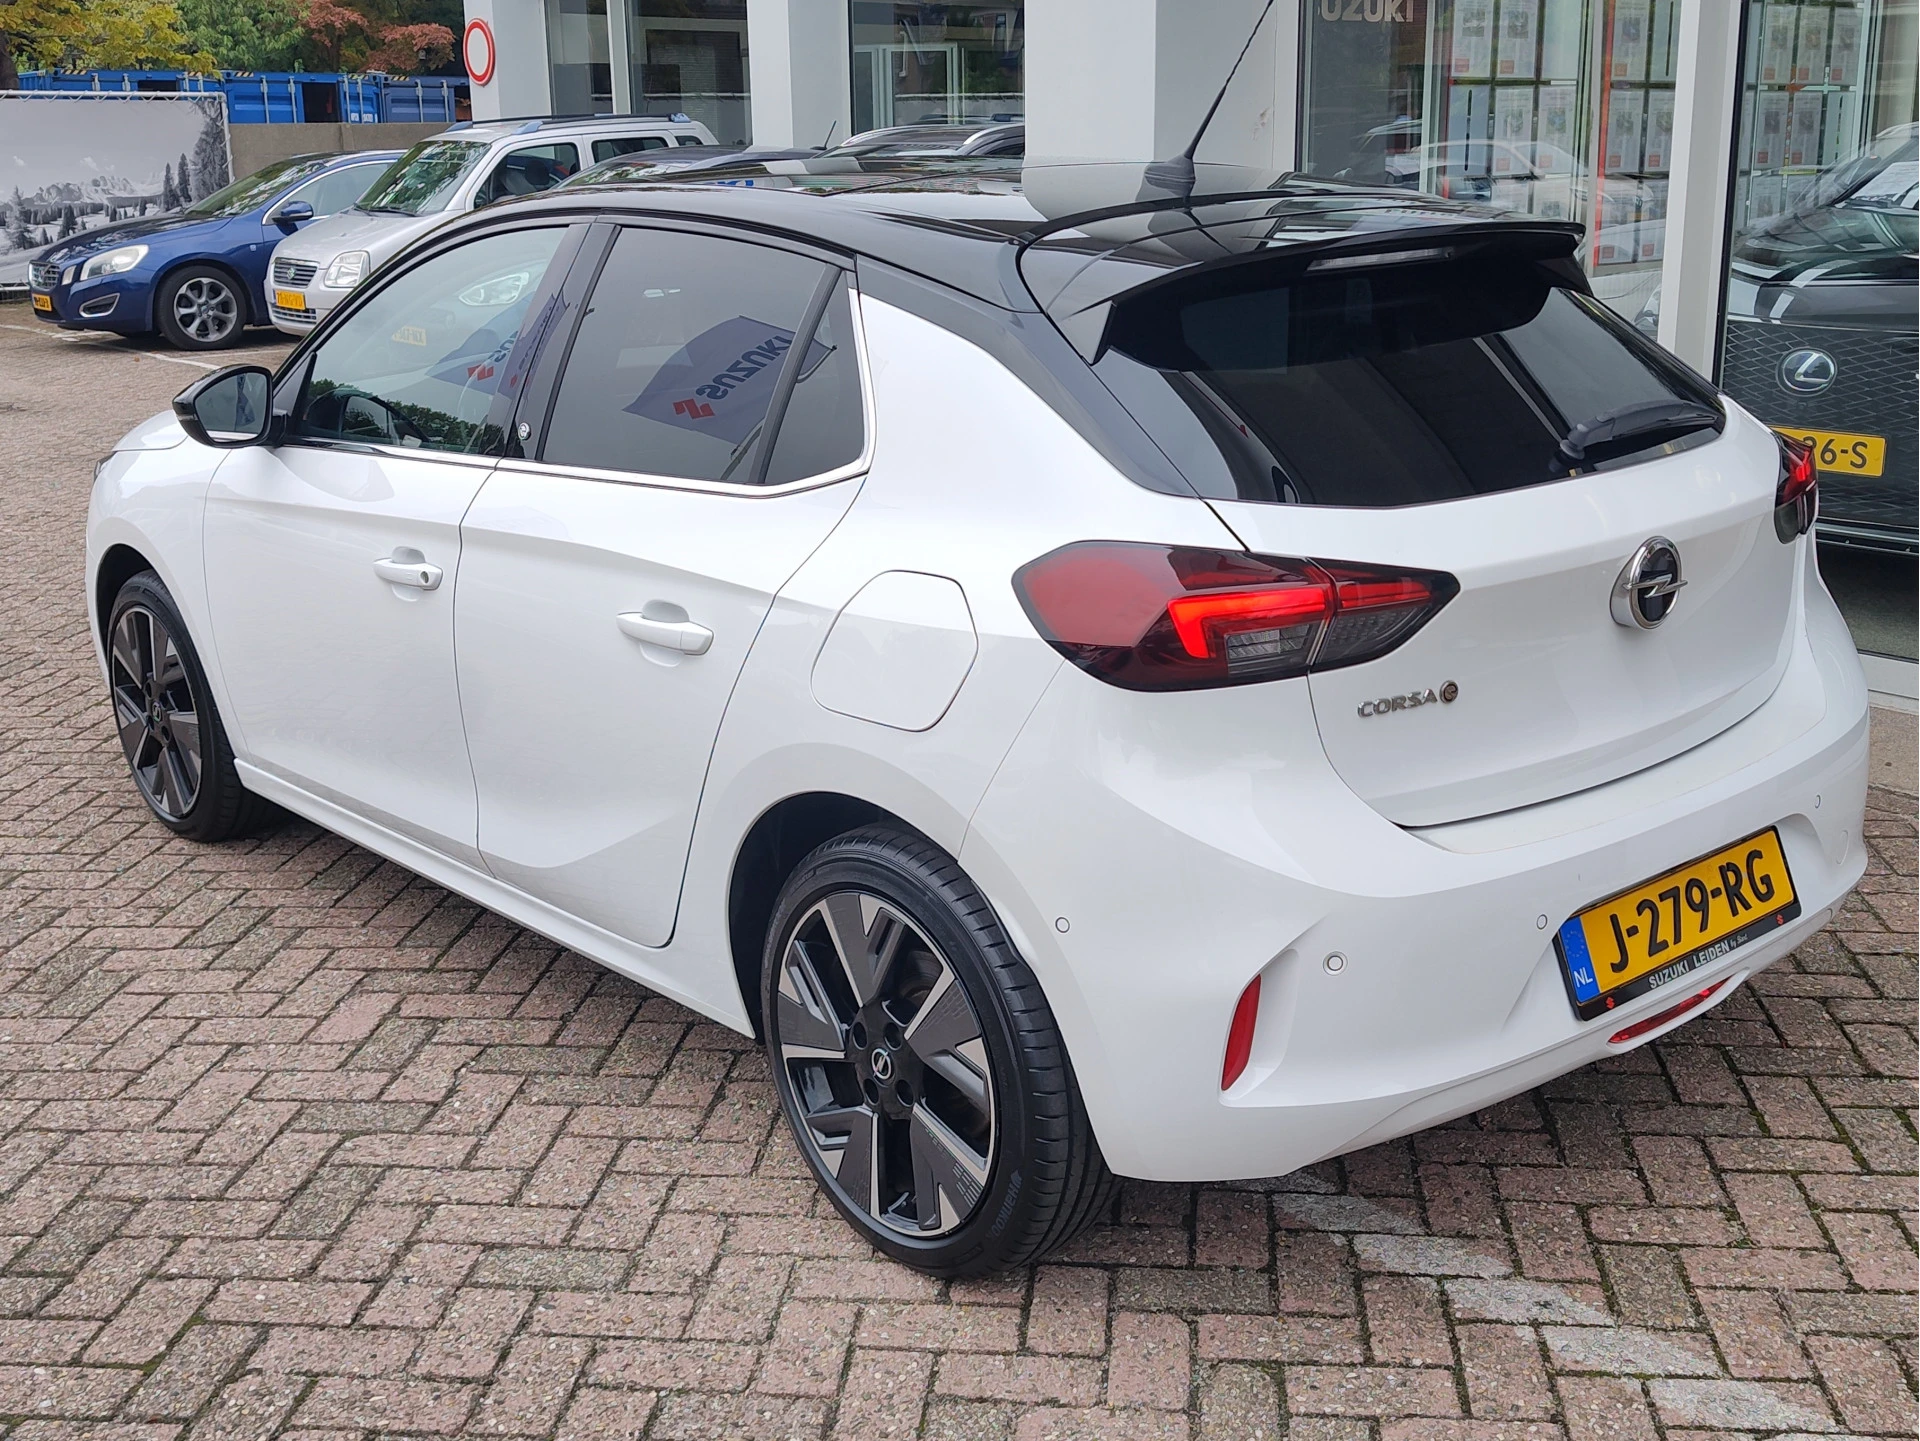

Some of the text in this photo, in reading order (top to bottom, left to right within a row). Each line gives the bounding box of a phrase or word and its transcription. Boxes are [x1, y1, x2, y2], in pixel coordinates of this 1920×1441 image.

[1317, 0, 1413, 22] UZUKI
[1357, 688, 1438, 717] CORSA
[1609, 848, 1776, 974] J-279-RG
[1573, 966, 1594, 988] NL
[1648, 962, 1690, 989] SUZUKI
[1692, 939, 1730, 968] LEIDEN
